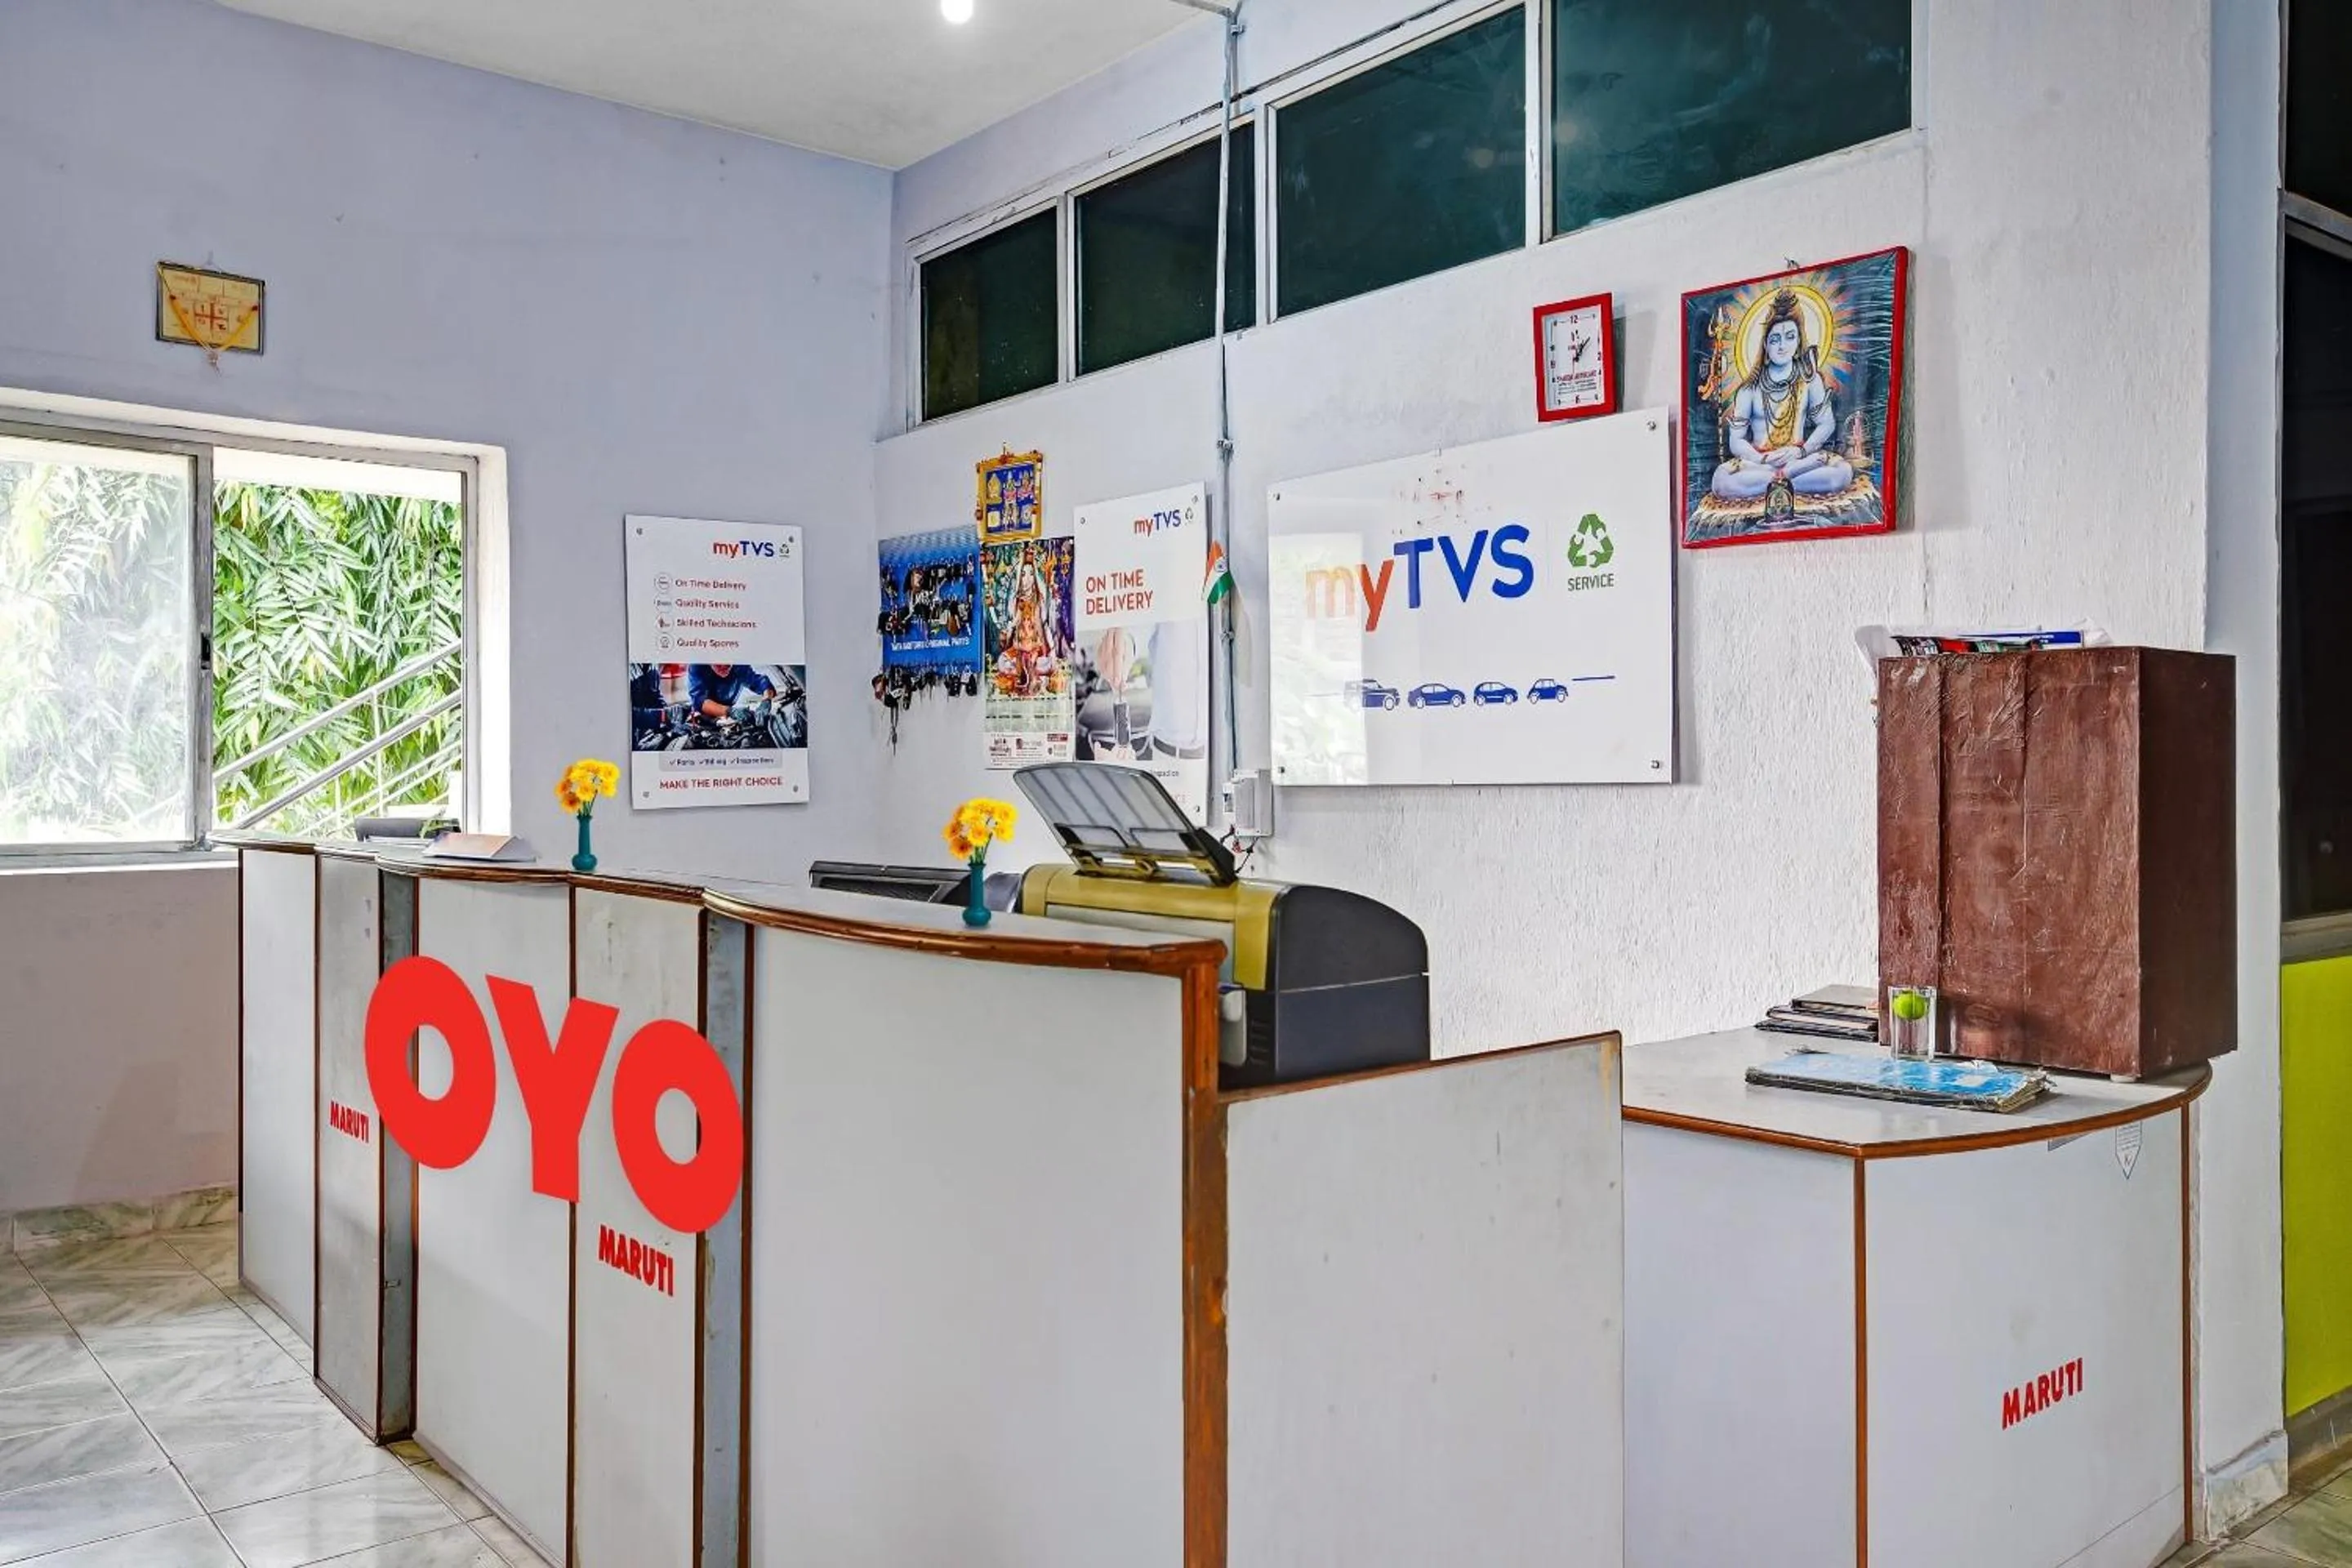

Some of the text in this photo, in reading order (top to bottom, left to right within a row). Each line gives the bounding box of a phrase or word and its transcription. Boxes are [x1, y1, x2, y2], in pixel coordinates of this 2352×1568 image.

[1134, 509, 1181, 537] myTVS
[712, 540, 775, 559] myTVS
[1085, 568, 1144, 593] ON TIME
[1307, 523, 1535, 633] myTVS
[1567, 573, 1615, 592] SERVICE
[1085, 590, 1154, 615] DELIVERY
[659, 776, 783, 790] MAKE THE RIGHT CHOICE
[330, 1100, 369, 1143] MARUTI
[598, 1224, 675, 1297] MARUTI
[2001, 1357, 2084, 1431] MARUTI
